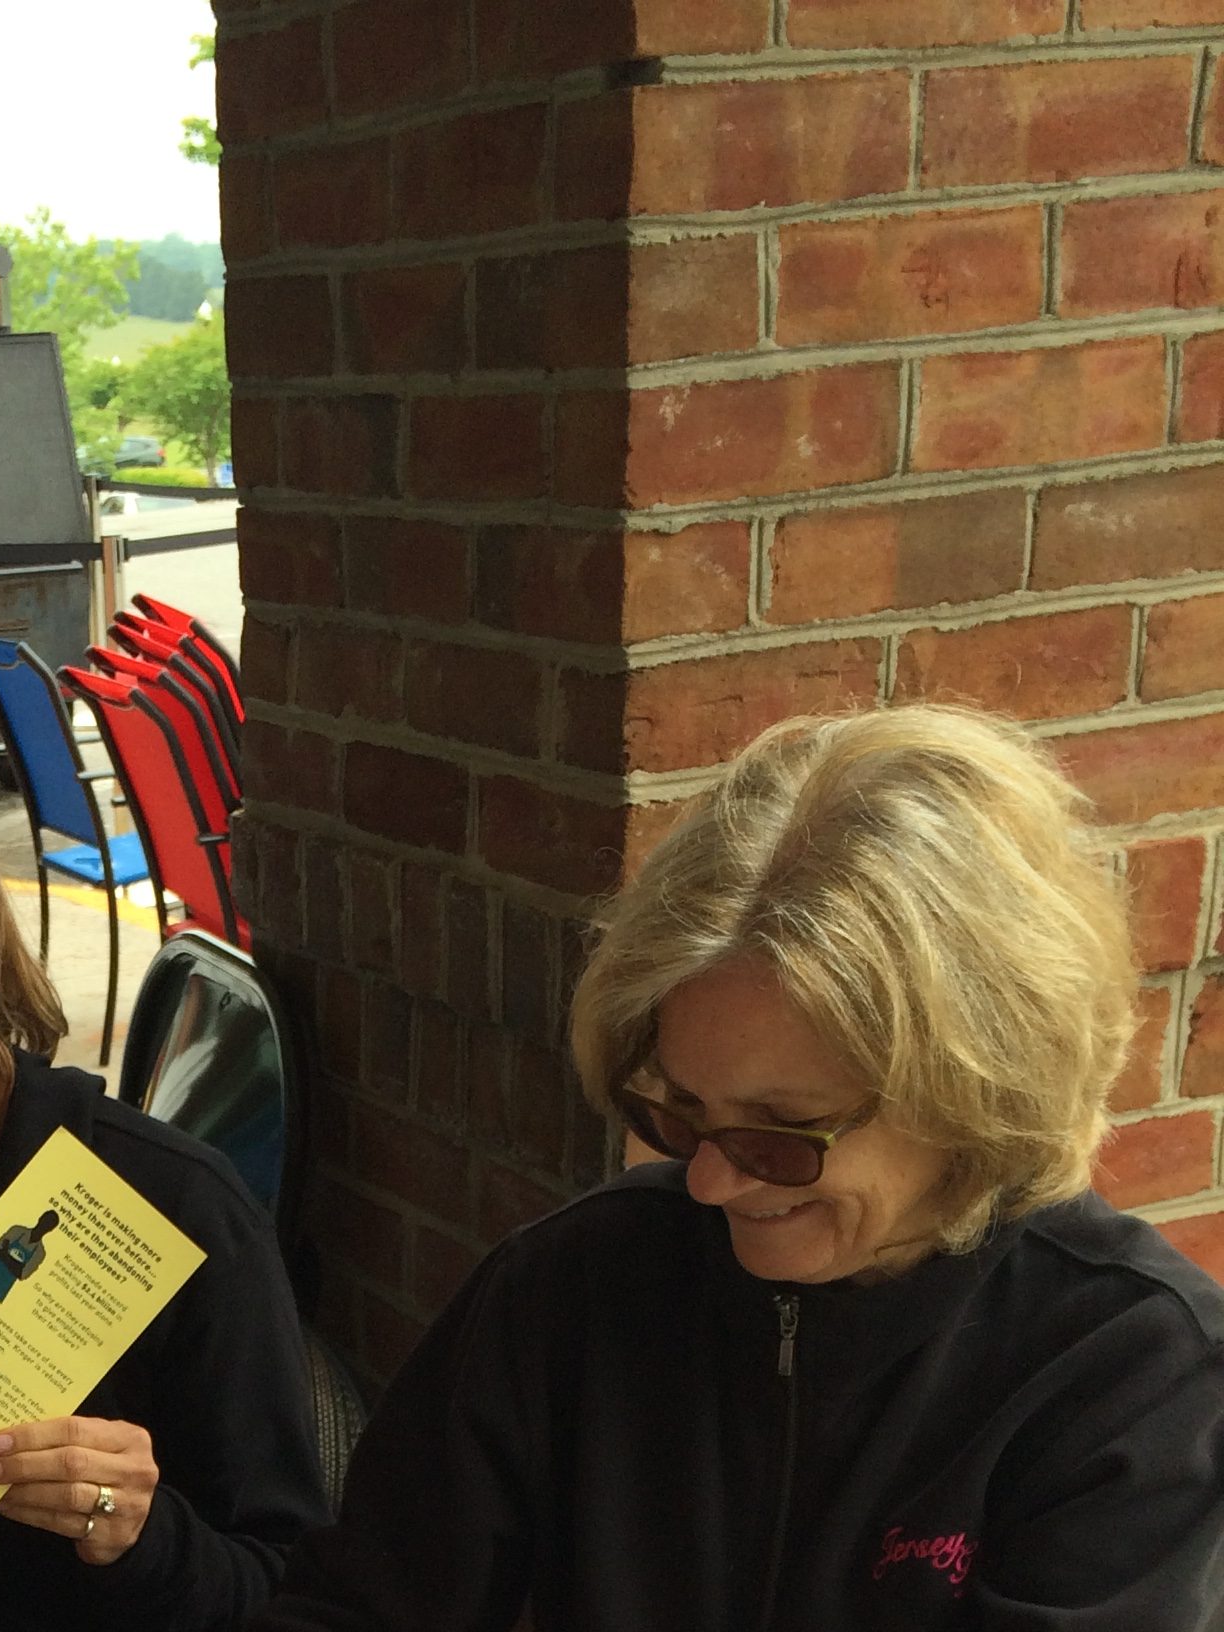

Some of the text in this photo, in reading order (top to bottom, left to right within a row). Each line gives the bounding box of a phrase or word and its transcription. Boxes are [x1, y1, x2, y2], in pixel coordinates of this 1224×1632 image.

[45, 1196, 154, 1292] so why are they abandoning
[57, 1221, 127, 1286] their employees?
[58, 1188, 88, 1217] money
[86, 1211, 108, 1232] than
[104, 1229, 125, 1248] ever
[72, 1182, 162, 1263] Kroger is making more
